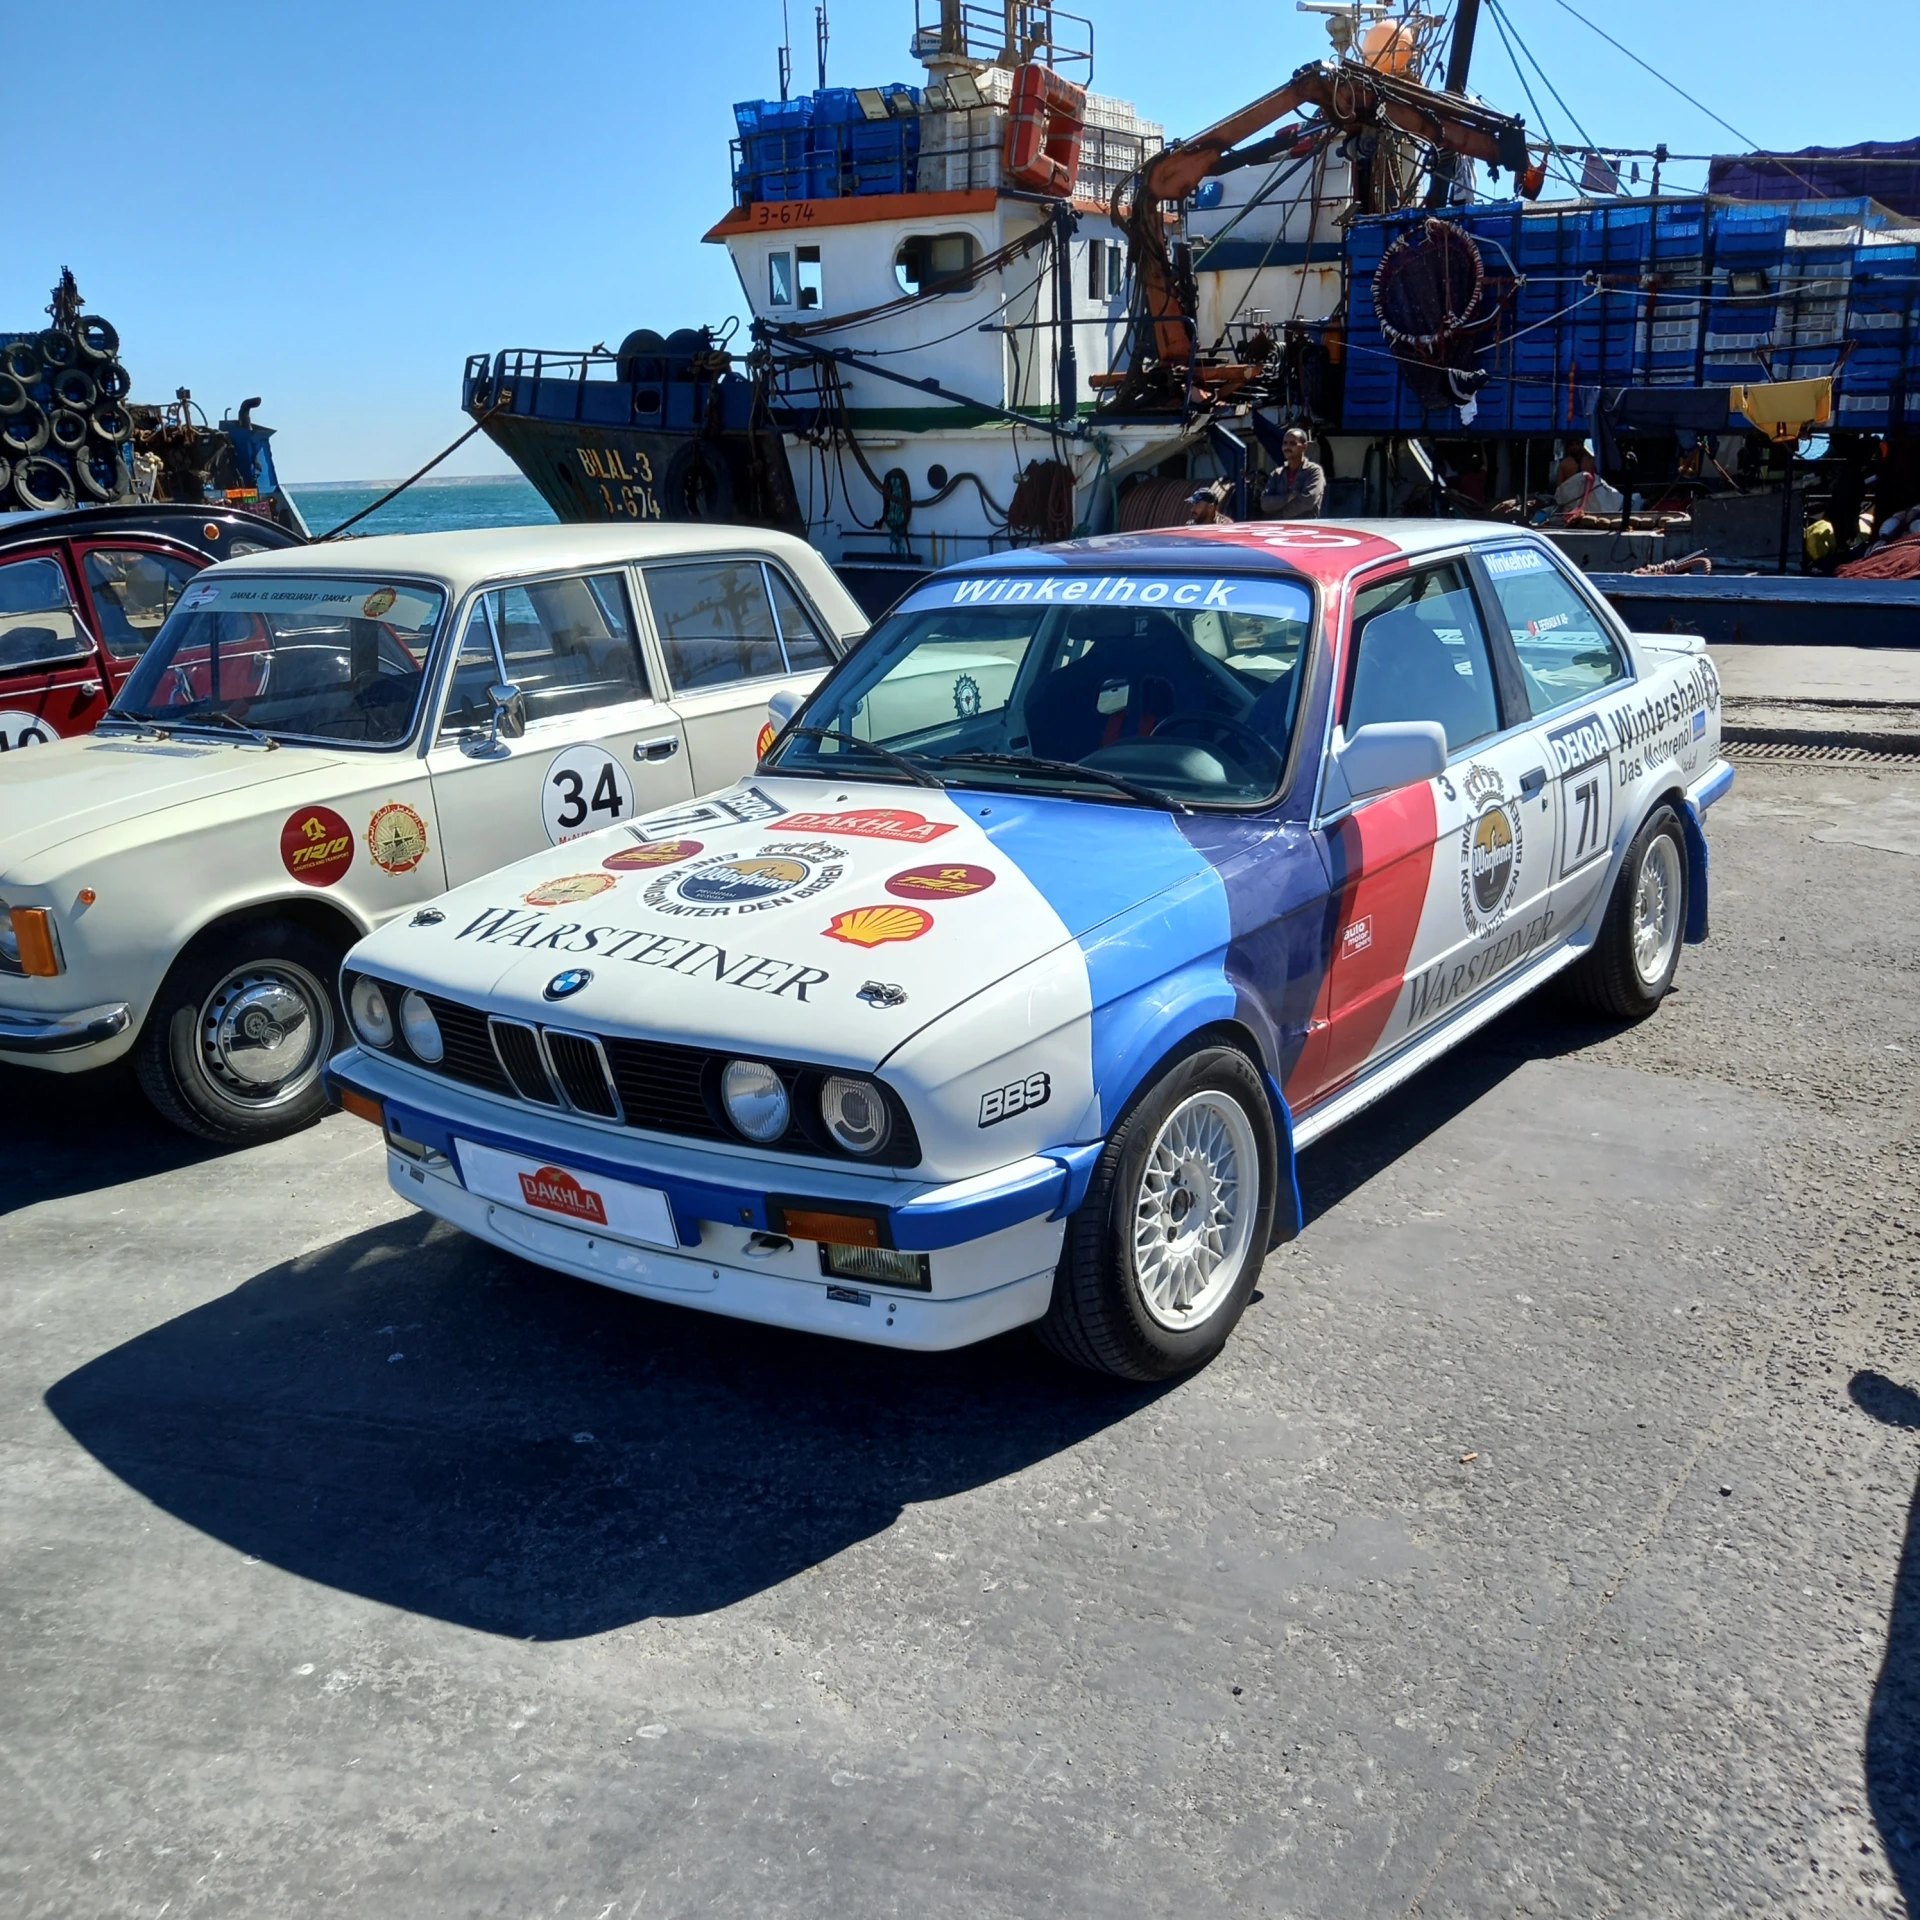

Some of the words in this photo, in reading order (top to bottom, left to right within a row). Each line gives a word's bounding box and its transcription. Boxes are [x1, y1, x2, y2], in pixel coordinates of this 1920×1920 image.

[758, 202, 815, 225] 3-674
[1481, 549, 1542, 574] Winkelhock
[230, 591, 257, 600] DAKHLA
[260, 592, 269, 600] EL
[321, 594, 353, 603] DAKHLA
[952, 576, 1237, 607] Winkelhock
[1608, 667, 1705, 754] Wintershall
[1550, 721, 1611, 774] DEKRA
[1618, 758, 1643, 787] Das
[1643, 719, 1693, 771] Motorenöl
[552, 762, 623, 828] 34
[1437, 774, 1457, 802] 3
[786, 814, 937, 837] DAKHLA
[1574, 776, 1598, 859] 71
[292, 836, 349, 865] TIRSO
[683, 852, 739, 871] EINE
[792, 863, 845, 900] BIEREN
[1504, 869, 1520, 910] DEN
[656, 903, 730, 918] UNTER
[738, 896, 794, 915] DEN
[1343, 922, 1366, 941] auto
[1347, 930, 1369, 947] motor
[978, 1071, 1051, 1129] BBS
[522, 1177, 600, 1213] DAKHLA
